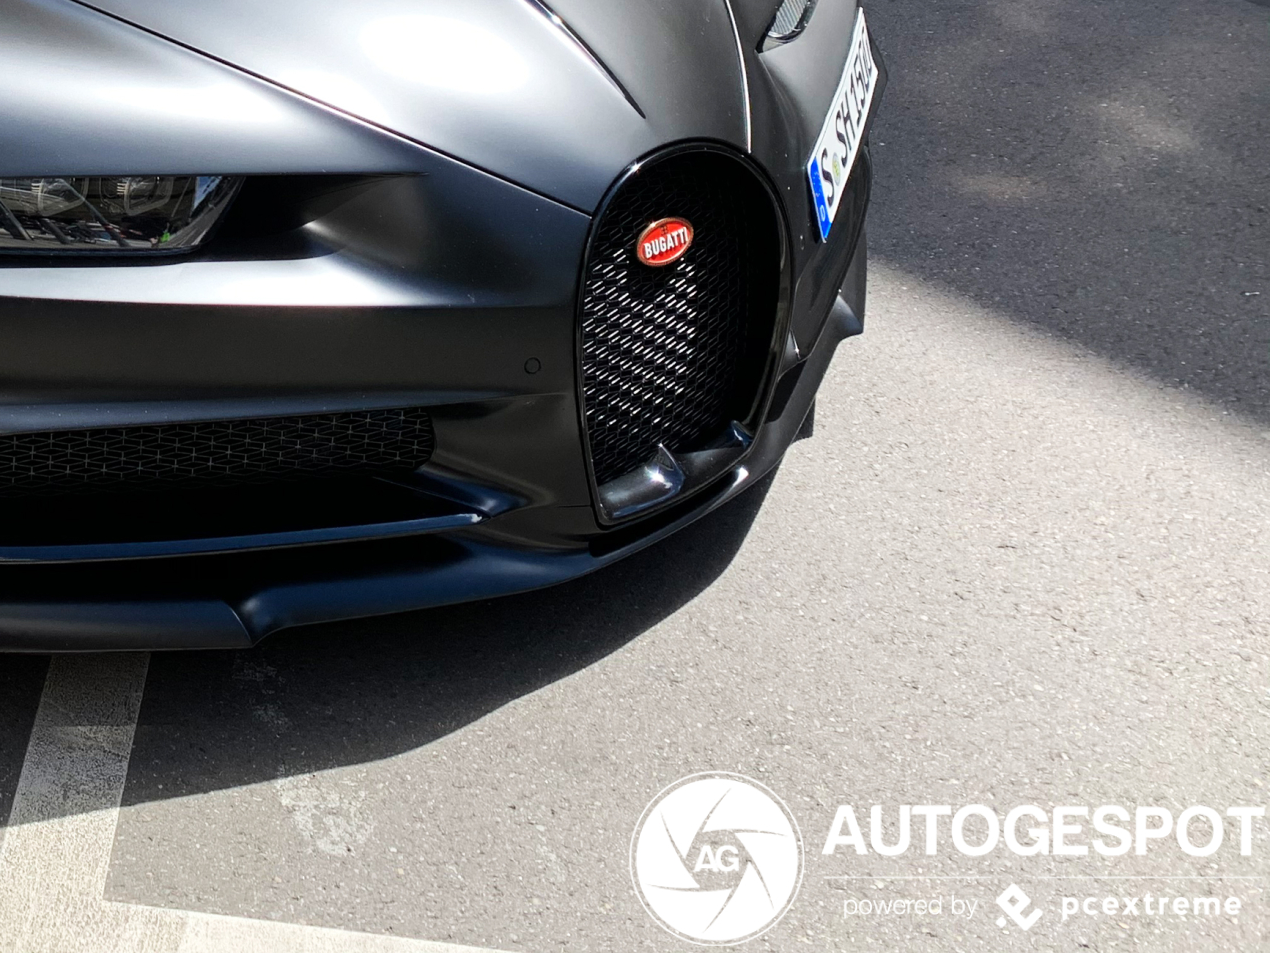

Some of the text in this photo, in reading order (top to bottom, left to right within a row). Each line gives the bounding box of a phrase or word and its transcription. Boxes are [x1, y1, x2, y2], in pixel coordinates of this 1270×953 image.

[821, 147, 835, 208] S
[836, 89, 856, 169] SH
[644, 226, 689, 259] BUGATTI
